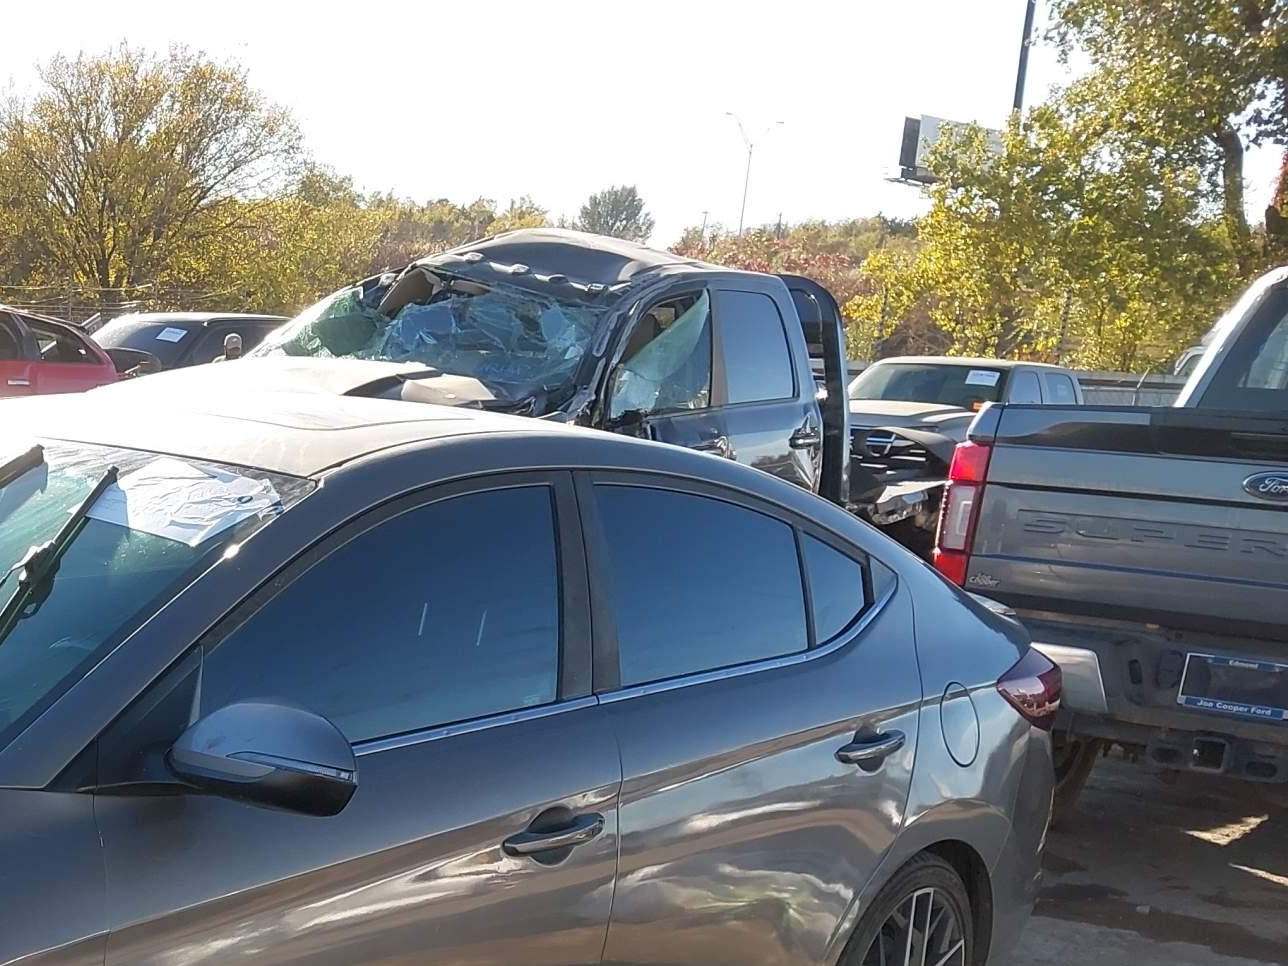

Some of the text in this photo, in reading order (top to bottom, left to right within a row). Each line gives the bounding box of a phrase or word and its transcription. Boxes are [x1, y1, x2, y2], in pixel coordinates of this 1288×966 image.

[1023, 515, 1288, 558] SUPER
[1196, 699, 1272, 716] Joe Cooper Ford
